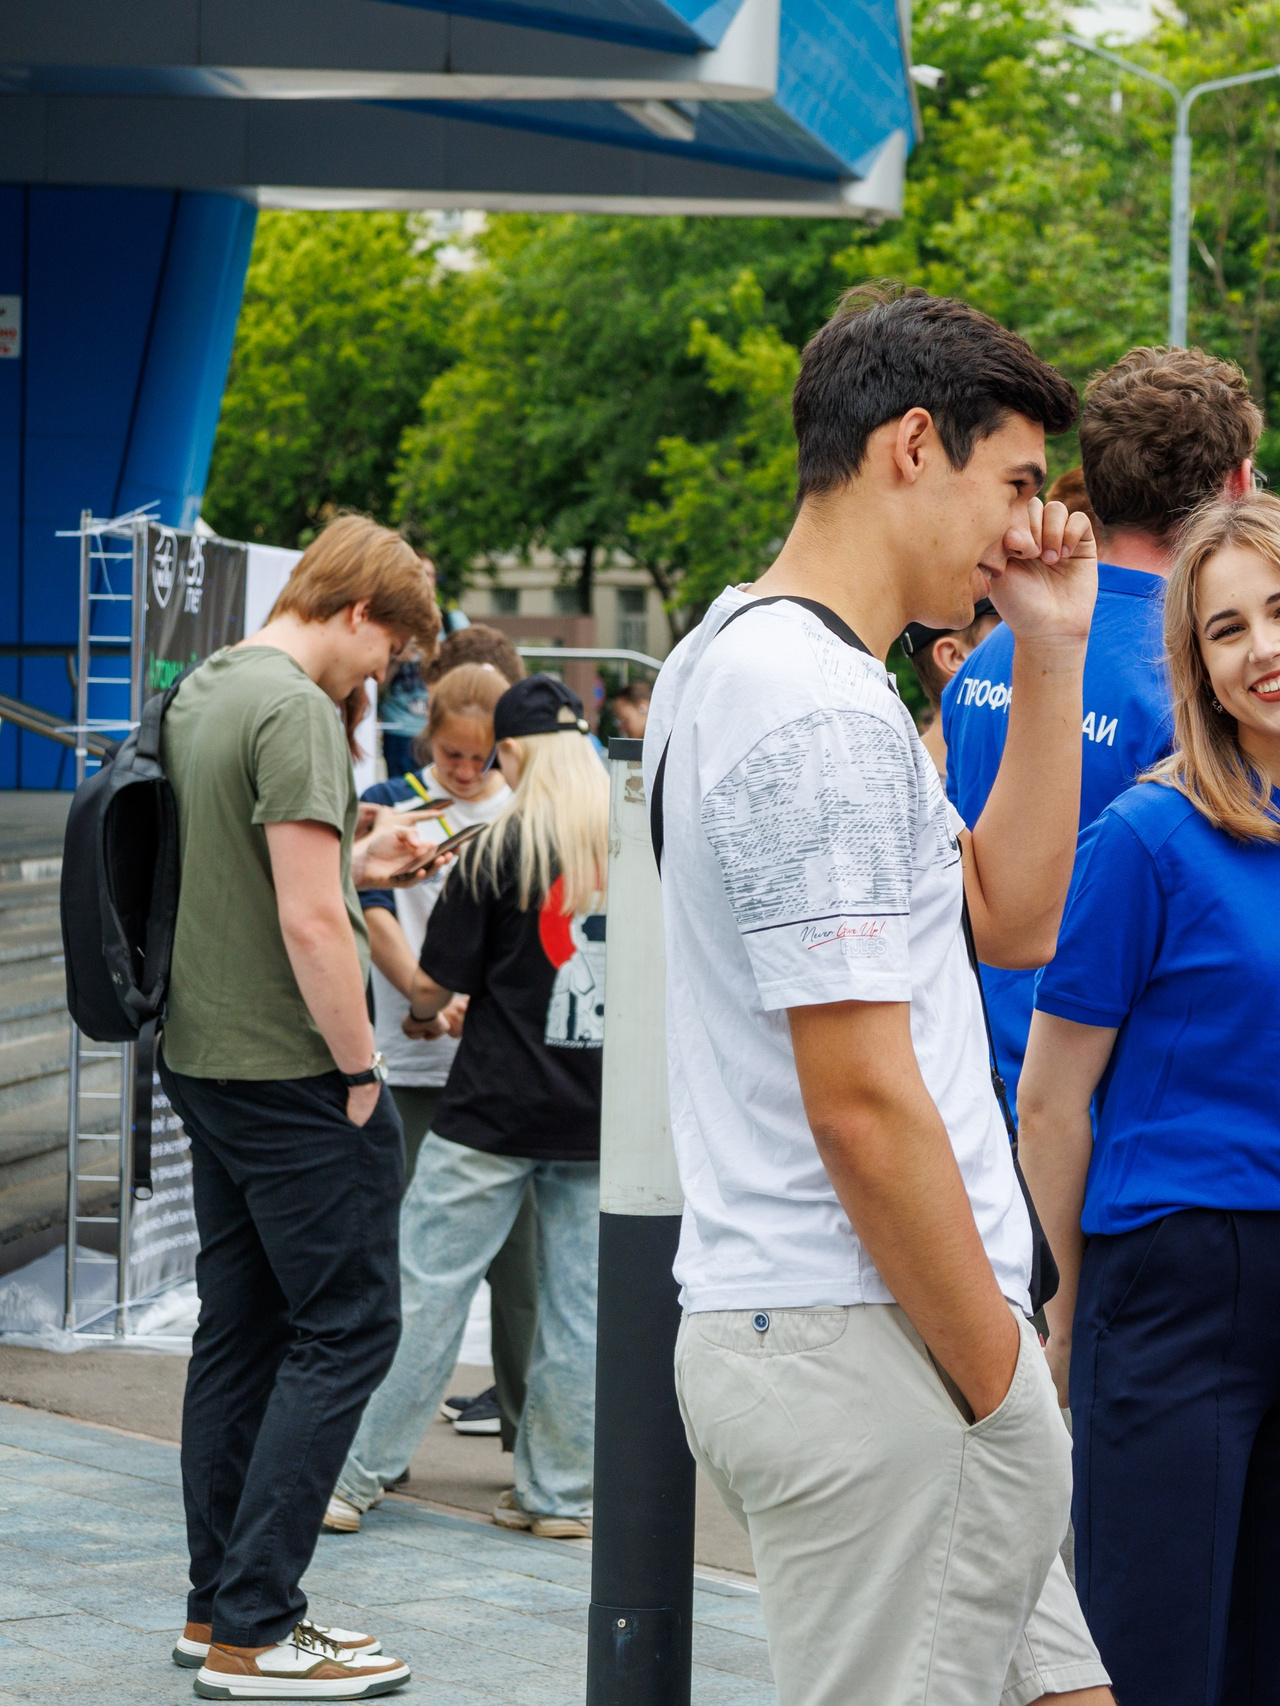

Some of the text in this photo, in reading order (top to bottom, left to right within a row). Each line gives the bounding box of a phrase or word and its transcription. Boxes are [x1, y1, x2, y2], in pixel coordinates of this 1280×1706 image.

[801, 920, 886, 942] Never Give Up!
